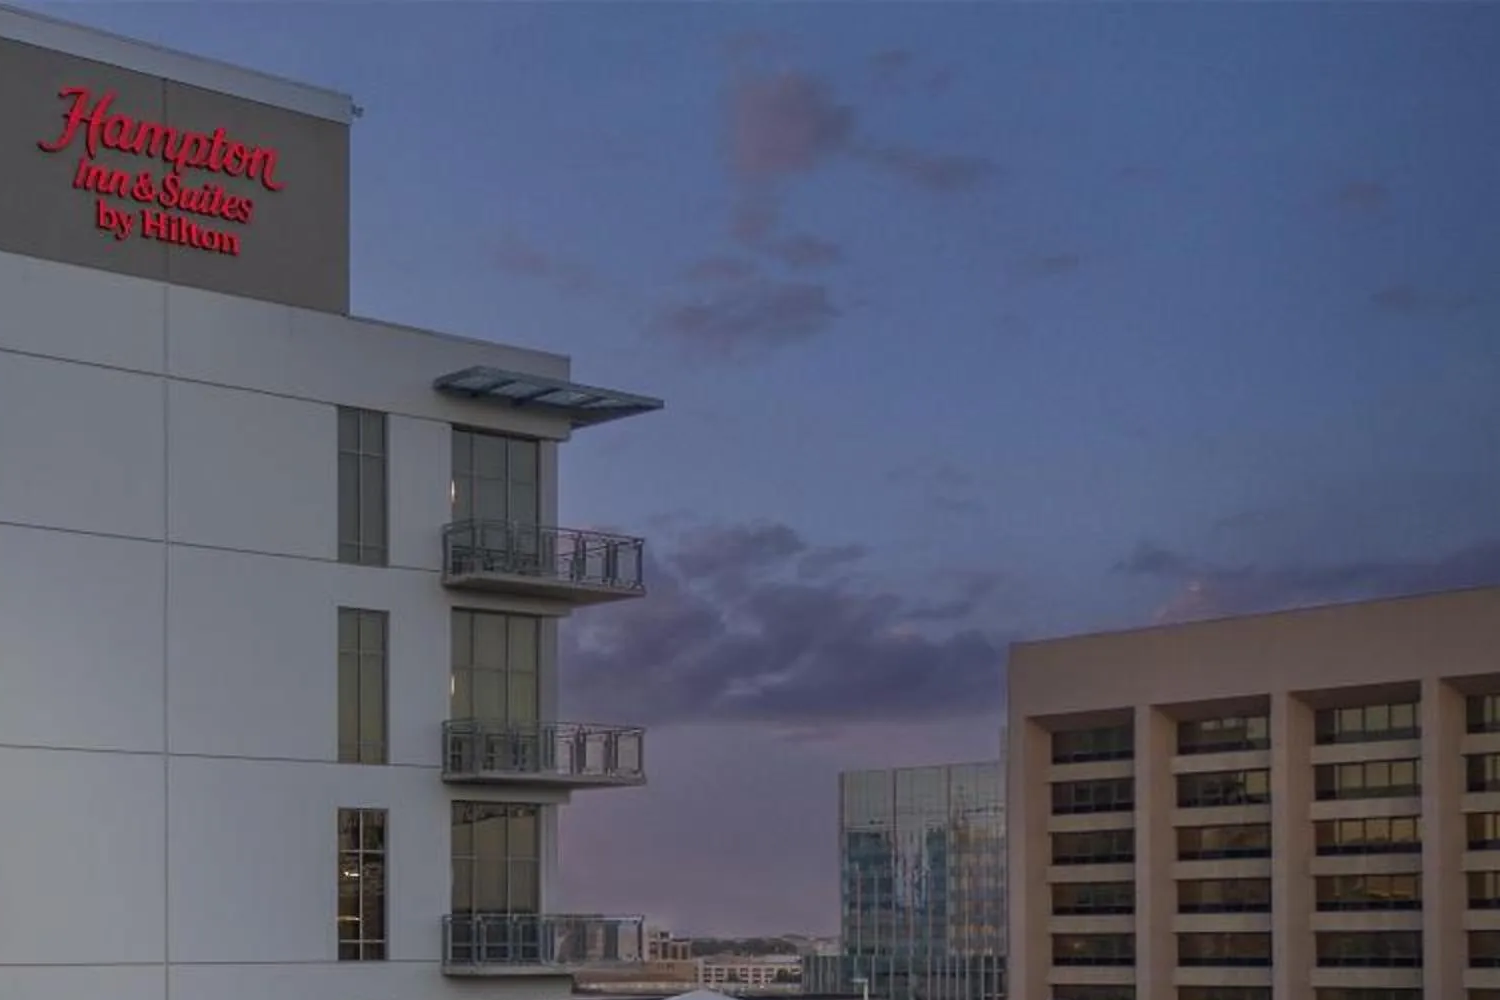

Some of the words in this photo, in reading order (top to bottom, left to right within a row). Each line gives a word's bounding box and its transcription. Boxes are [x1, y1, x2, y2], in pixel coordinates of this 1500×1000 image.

[38, 85, 287, 191] Hampton
[97, 198, 134, 240] by
[141, 208, 240, 256] Hilton
